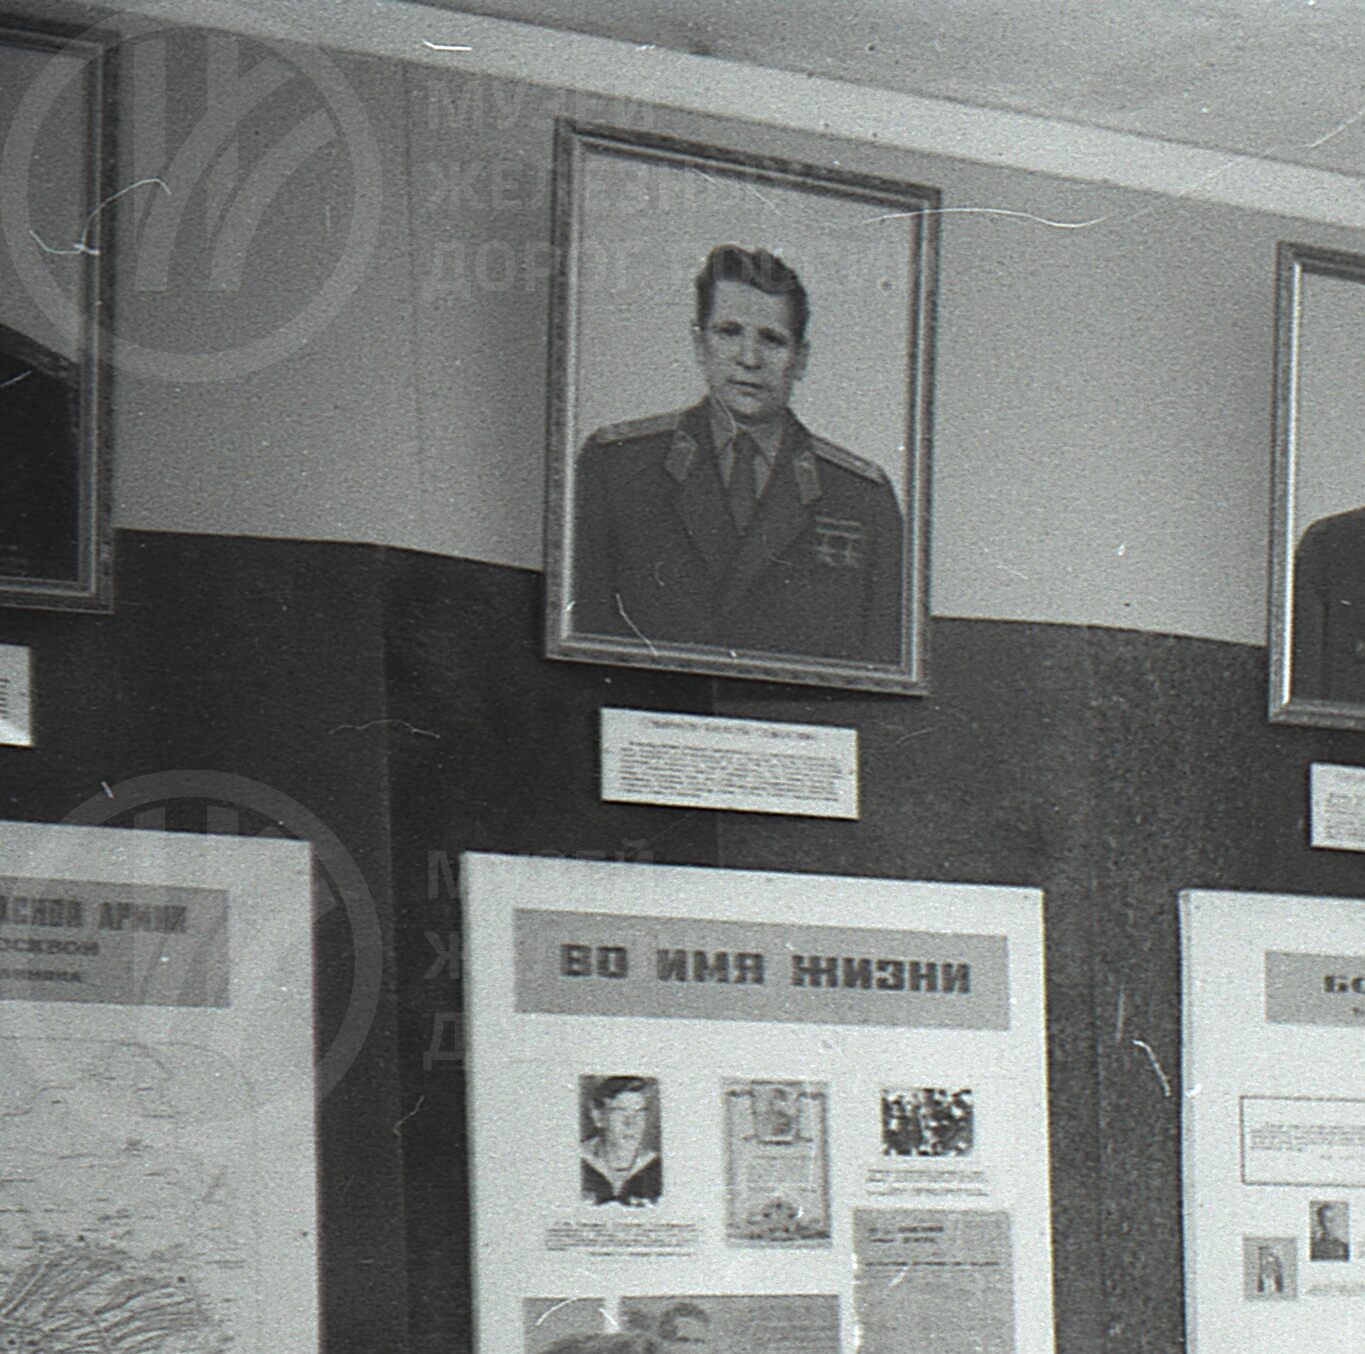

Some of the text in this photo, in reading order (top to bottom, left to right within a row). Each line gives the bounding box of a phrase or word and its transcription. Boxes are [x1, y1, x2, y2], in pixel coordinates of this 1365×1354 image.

[559, 942, 972, 995] ВО ИМЯ ЖИЗНИ
